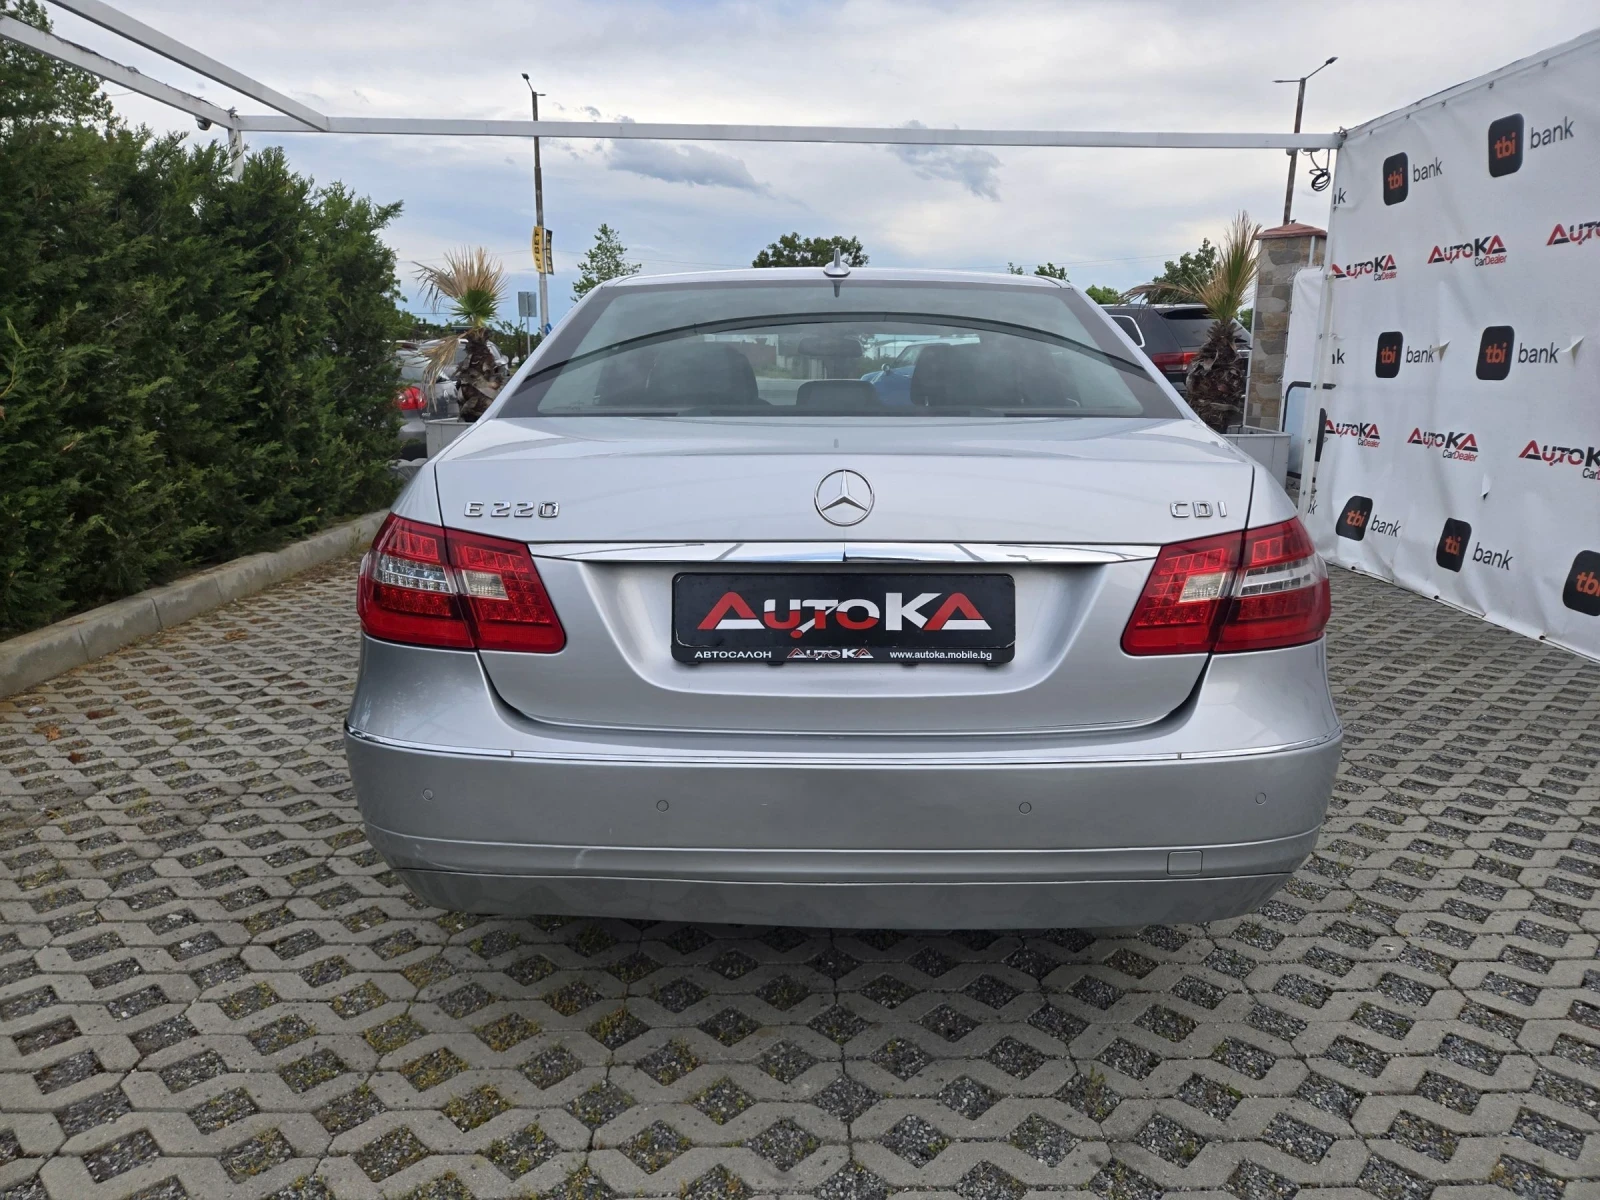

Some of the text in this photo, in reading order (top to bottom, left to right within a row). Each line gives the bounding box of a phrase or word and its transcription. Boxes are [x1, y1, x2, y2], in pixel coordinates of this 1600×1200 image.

[1494, 115, 1575, 159] tbi bank
[1387, 157, 1443, 190] tbi bank
[1380, 345, 1434, 364] tbi bank
[1485, 342, 1560, 364] tbi bank
[464, 501, 560, 518] E 220
[1170, 501, 1227, 518] CDI
[1346, 509, 1401, 538] tbi bank
[1445, 536, 1513, 570] tbi bank
[694, 650, 772, 659] АВТОСАЛОН
[889, 650, 993, 661] www.autoka.mobile.bg
